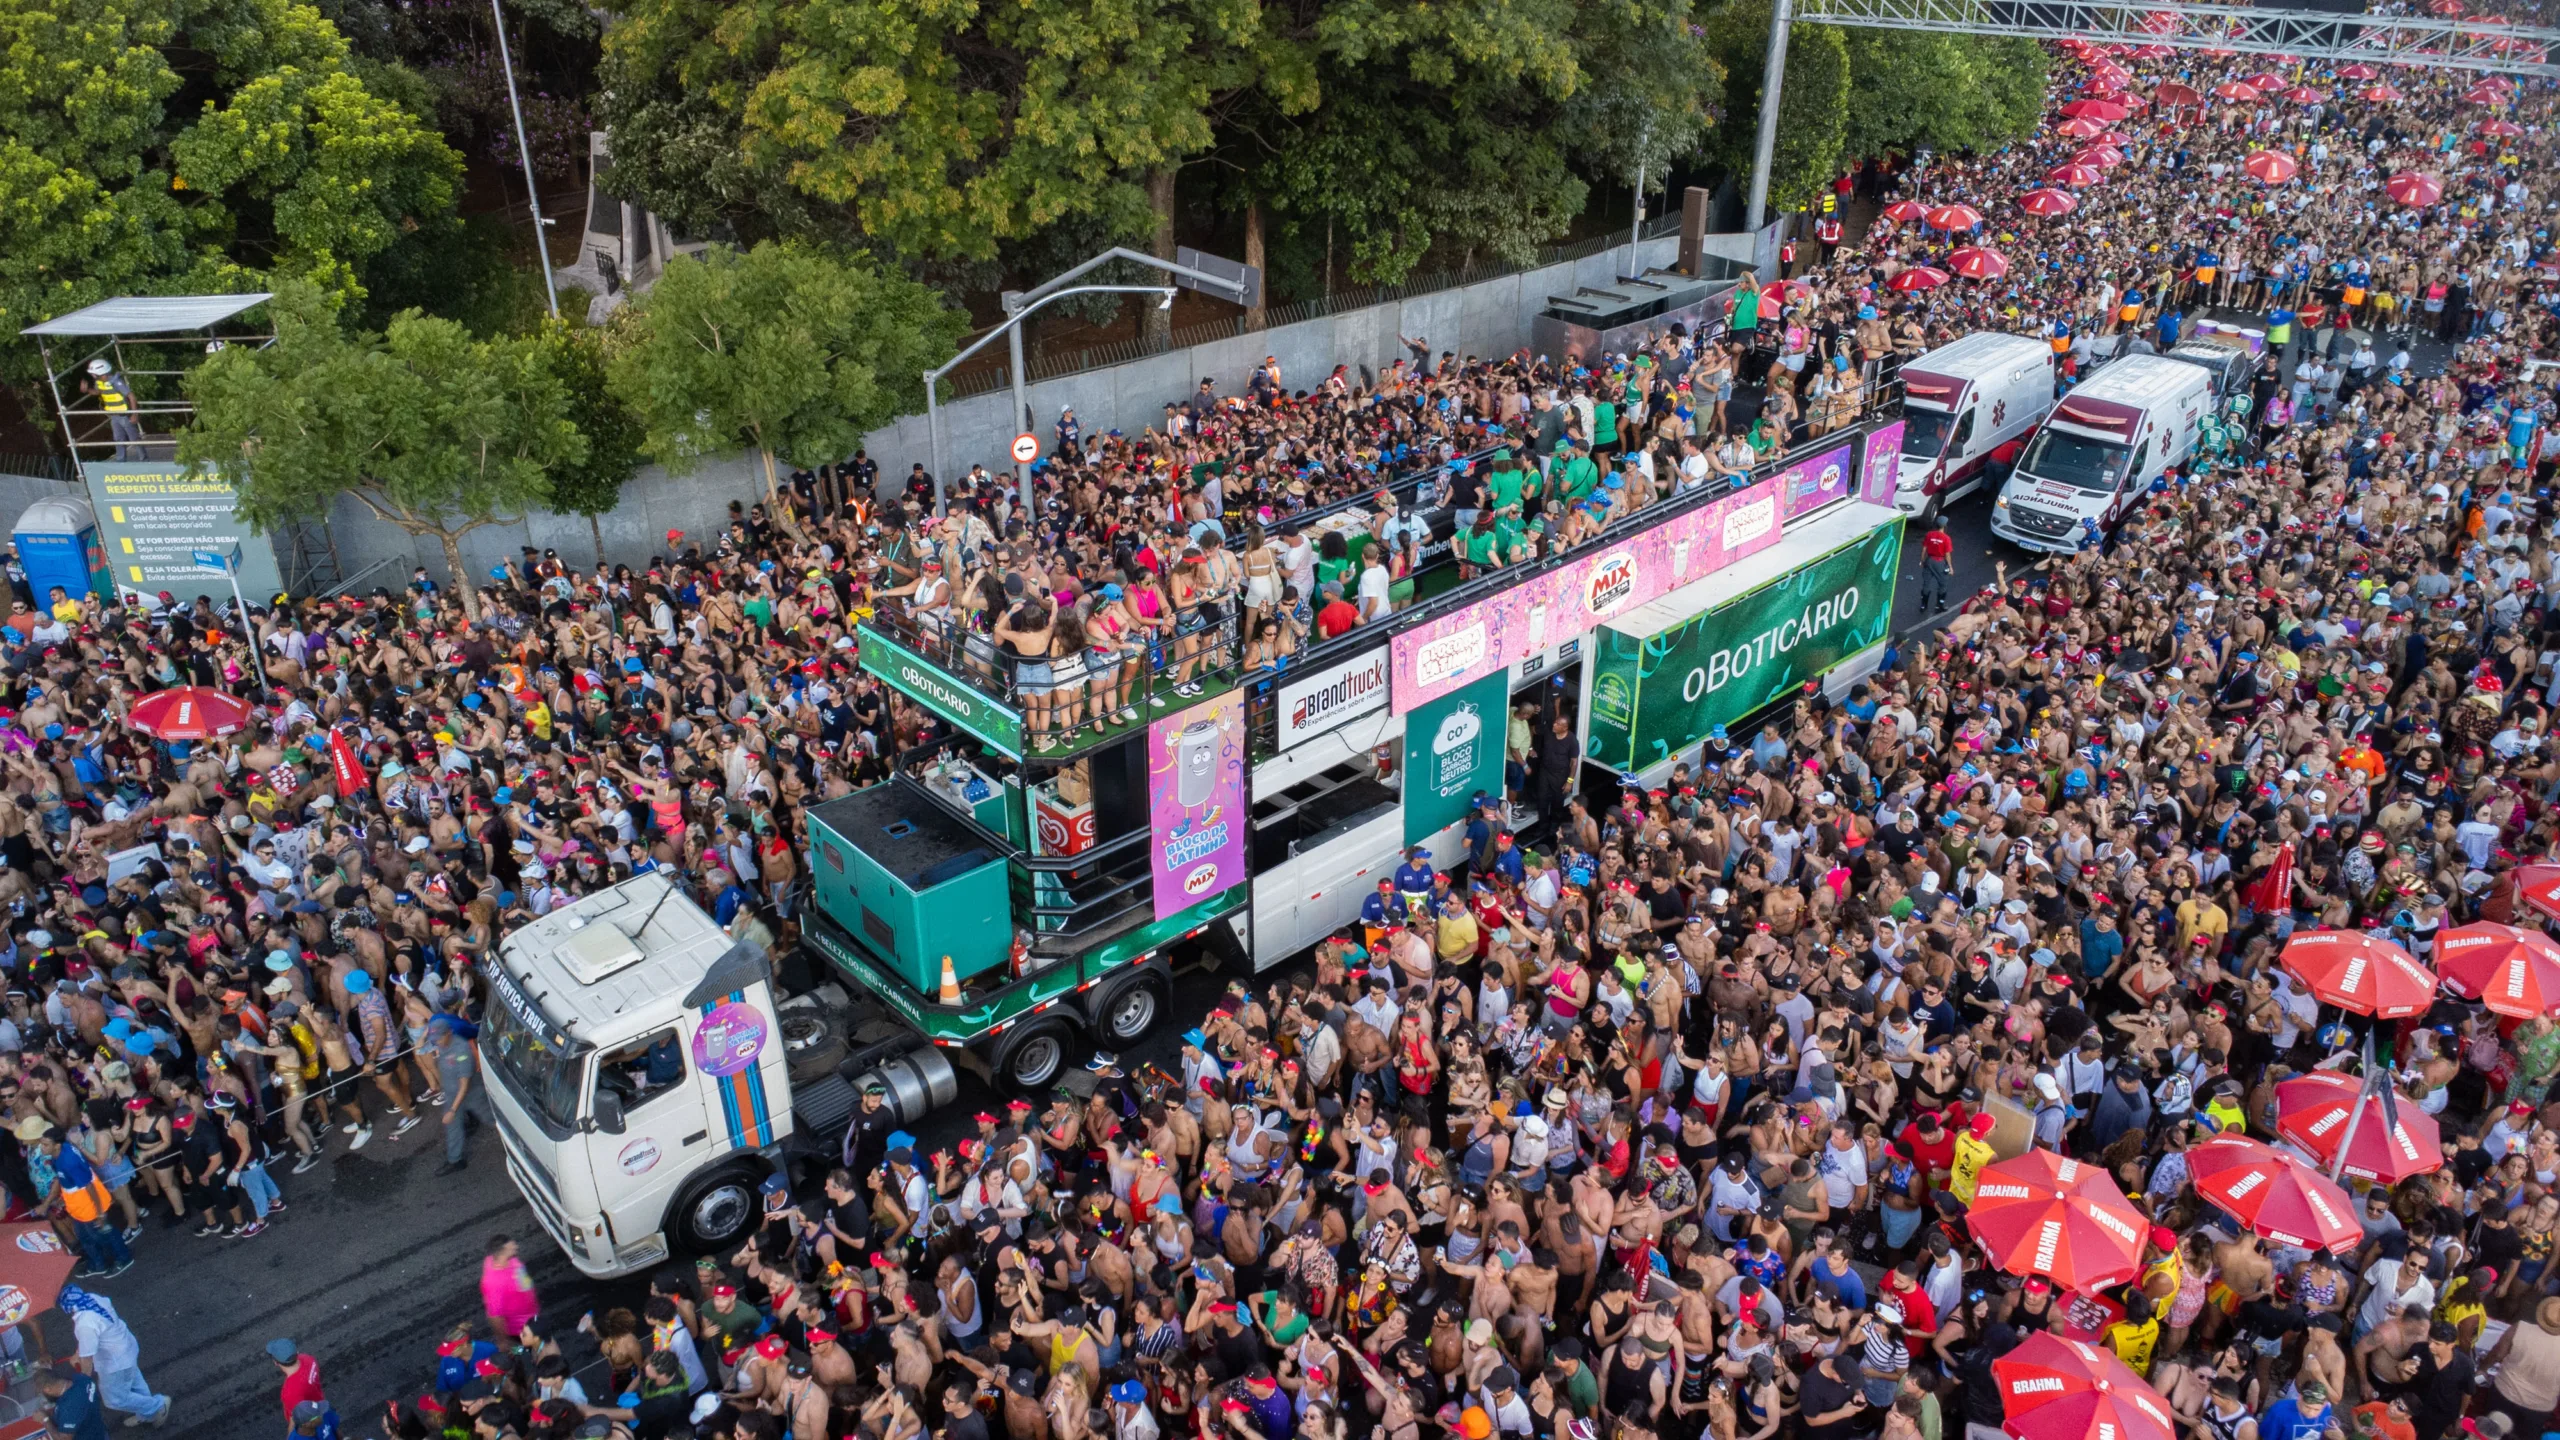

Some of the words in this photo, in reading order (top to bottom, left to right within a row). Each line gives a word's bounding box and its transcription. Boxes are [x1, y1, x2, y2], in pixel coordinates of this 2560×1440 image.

[104, 473, 163, 483] APROVEITE
[165, 474, 174, 482] A
[106, 485, 157, 494] RESPEITO
[159, 485, 166, 493] E
[168, 484, 233, 494] SEGURANÇA
[128, 506, 153, 514] FIQUE
[166, 505, 189, 513] OLHO
[191, 505, 204, 513] NO
[159, 513, 187, 522] objetos
[188, 513, 197, 521] de
[198, 513, 217, 521] valor
[168, 522, 213, 530] apropriados
[135, 537, 145, 545] SE
[164, 536, 194, 544] DIRIGIR
[196, 535, 214, 544] NÃO
[152, 544, 193, 552] consciente
[1591, 559, 1631, 600] MIX
[1308, 659, 1383, 717] Brandtruck
[1308, 706, 1346, 727] Experiências
[1348, 697, 1365, 709] sobre
[1366, 688, 1384, 700] rodas
[1440, 755, 1472, 775] CARBONO
[1441, 746, 1472, 768] BLOCO
[1440, 762, 1472, 784] NEUTRO
[1165, 829, 1210, 857] BLOCO
[1209, 821, 1228, 840] DA
[1166, 833, 1229, 872] LATINHA
[1188, 867, 1216, 891] MIX
[2291, 935, 2338, 946] BRAHMA
[2445, 936, 2492, 949] BRAHMA
[820, 935, 848, 962] BELEZA
[848, 957, 860, 971] DO
[863, 969, 878, 986] SEU
[882, 984, 922, 1021] CARNAVAL
[2340, 957, 2367, 994] BRAHMA
[2392, 953, 2431, 989] BRAHMA
[2507, 959, 2526, 998] BRAHMA
[488, 959, 501, 978] VIP
[496, 974, 525, 1013] SERVICE
[522, 1005, 546, 1036] TRUK
[739, 1043, 756, 1056] MIX
[2308, 1107, 2350, 1137] BRAHMA
[2344, 1165, 2378, 1180] BRAHMA
[1978, 1184, 2029, 1199] BRAHMA
[2226, 1170, 2267, 1200] BRAHMA
[2307, 1189, 2342, 1230] BRAHMA
[2089, 1203, 2137, 1244] BRAHMA
[2034, 1220, 2062, 1272] BRAHMA
[2269, 1230, 2304, 1246] BRAHMA
[2012, 1377, 2064, 1395] BRAHMA
